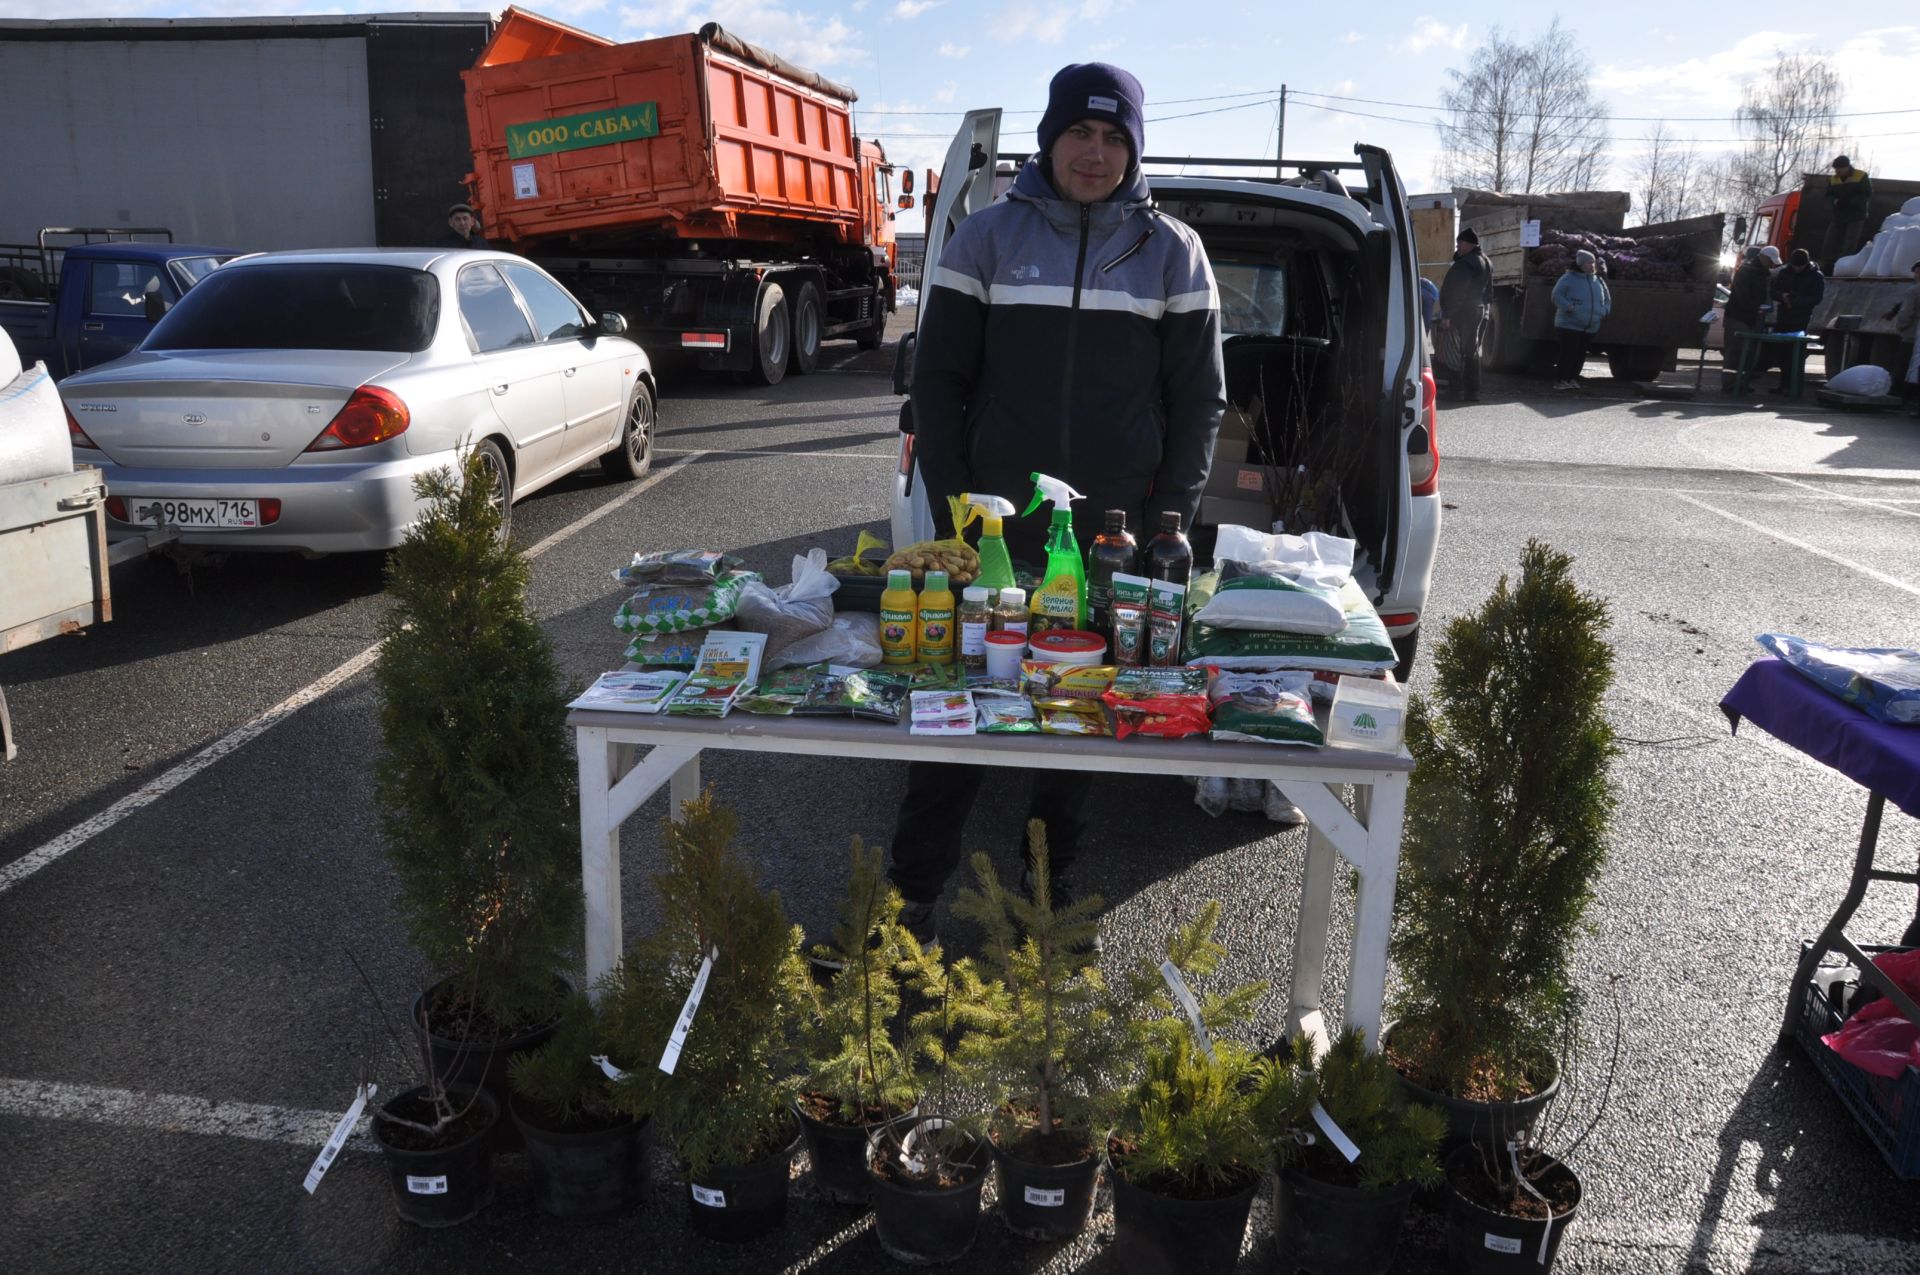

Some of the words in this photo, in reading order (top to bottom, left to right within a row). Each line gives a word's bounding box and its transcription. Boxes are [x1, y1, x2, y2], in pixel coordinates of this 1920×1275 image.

[528, 125, 569, 147] ООО
[574, 114, 638, 138] «САБА»
[219, 501, 250, 518] 716
[1126, 669, 1201, 677] ДЫМОКУР
